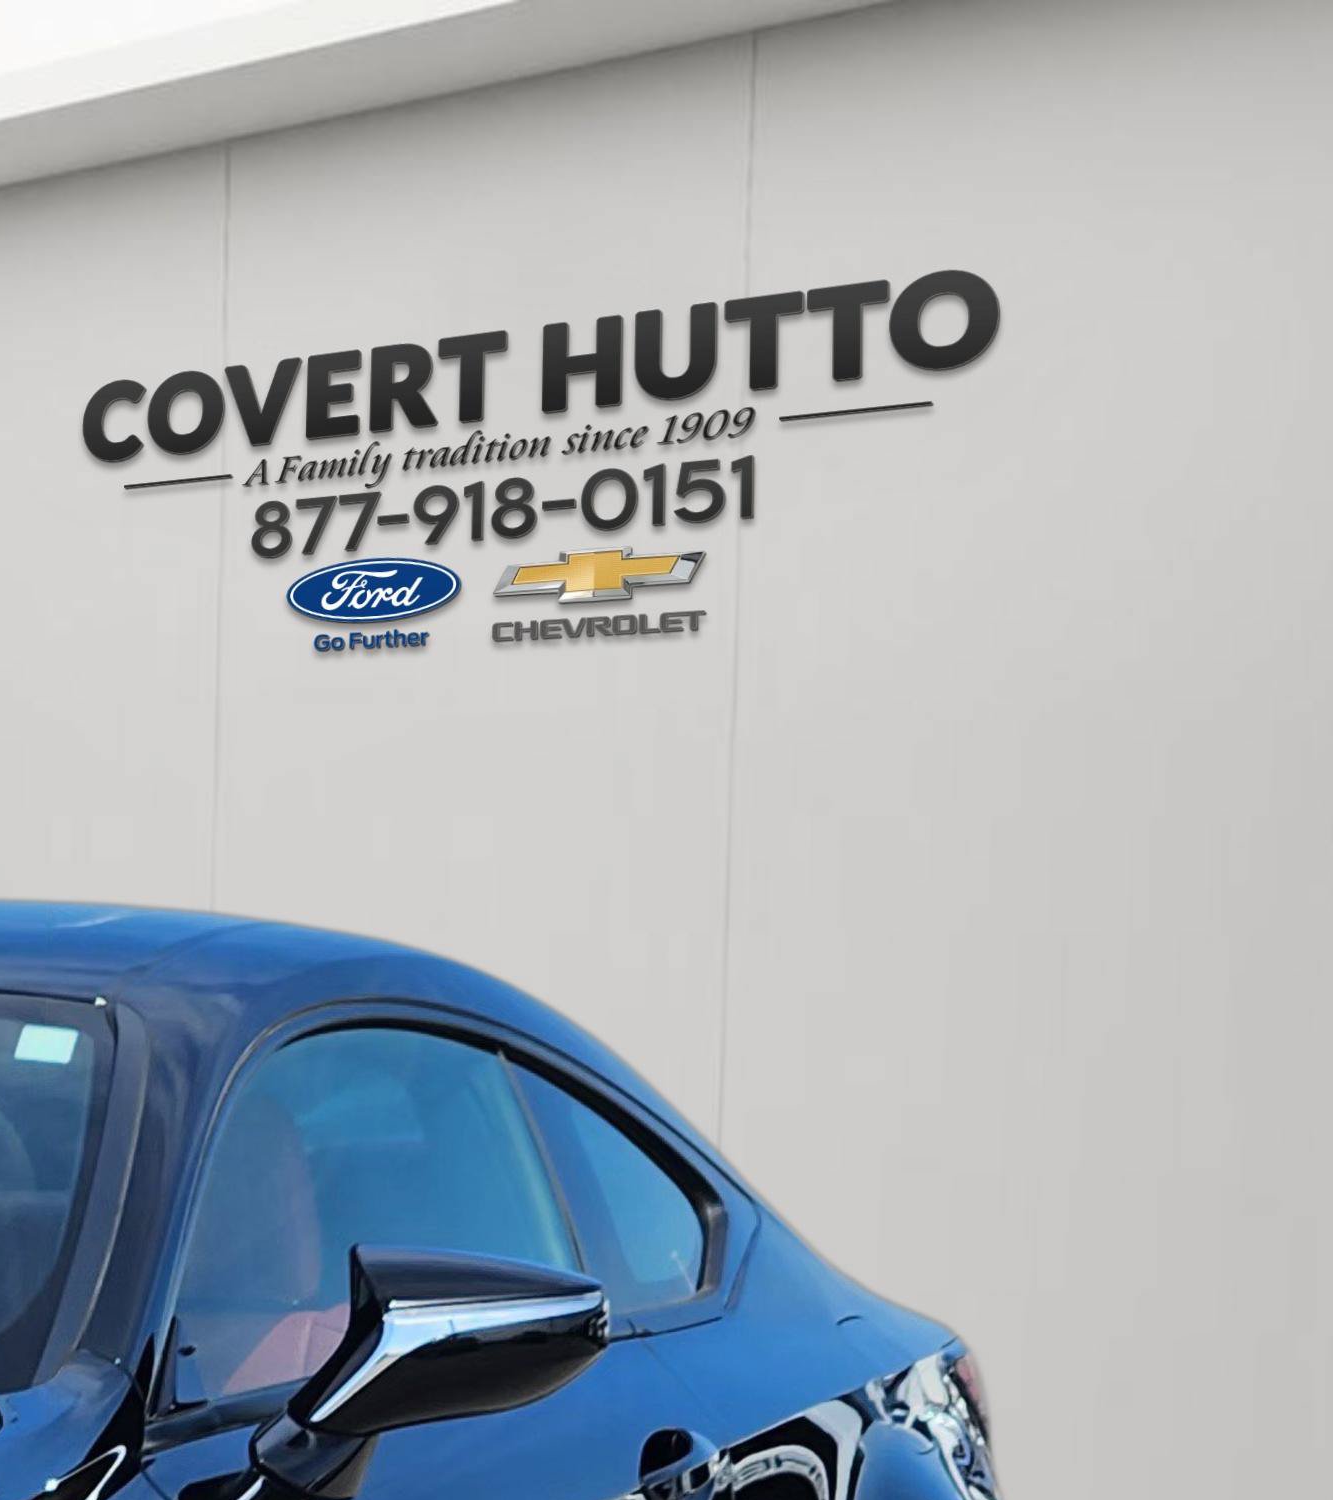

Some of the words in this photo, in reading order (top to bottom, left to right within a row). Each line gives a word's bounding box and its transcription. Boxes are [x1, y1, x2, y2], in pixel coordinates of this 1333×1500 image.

[82, 330, 510, 464] COVERT
[540, 269, 1002, 415] HUTTO
[242, 458, 270, 488] A
[275, 441, 393, 489] Family
[401, 429, 552, 472] tradition
[560, 424, 650, 457] since
[656, 405, 757, 448] 1909
[251, 455, 755, 560] 877-918-0151
[320, 569, 424, 611] Ford
[313, 633, 346, 653] Go
[349, 629, 431, 651] Further
[491, 609, 707, 644] CHEVROLET
